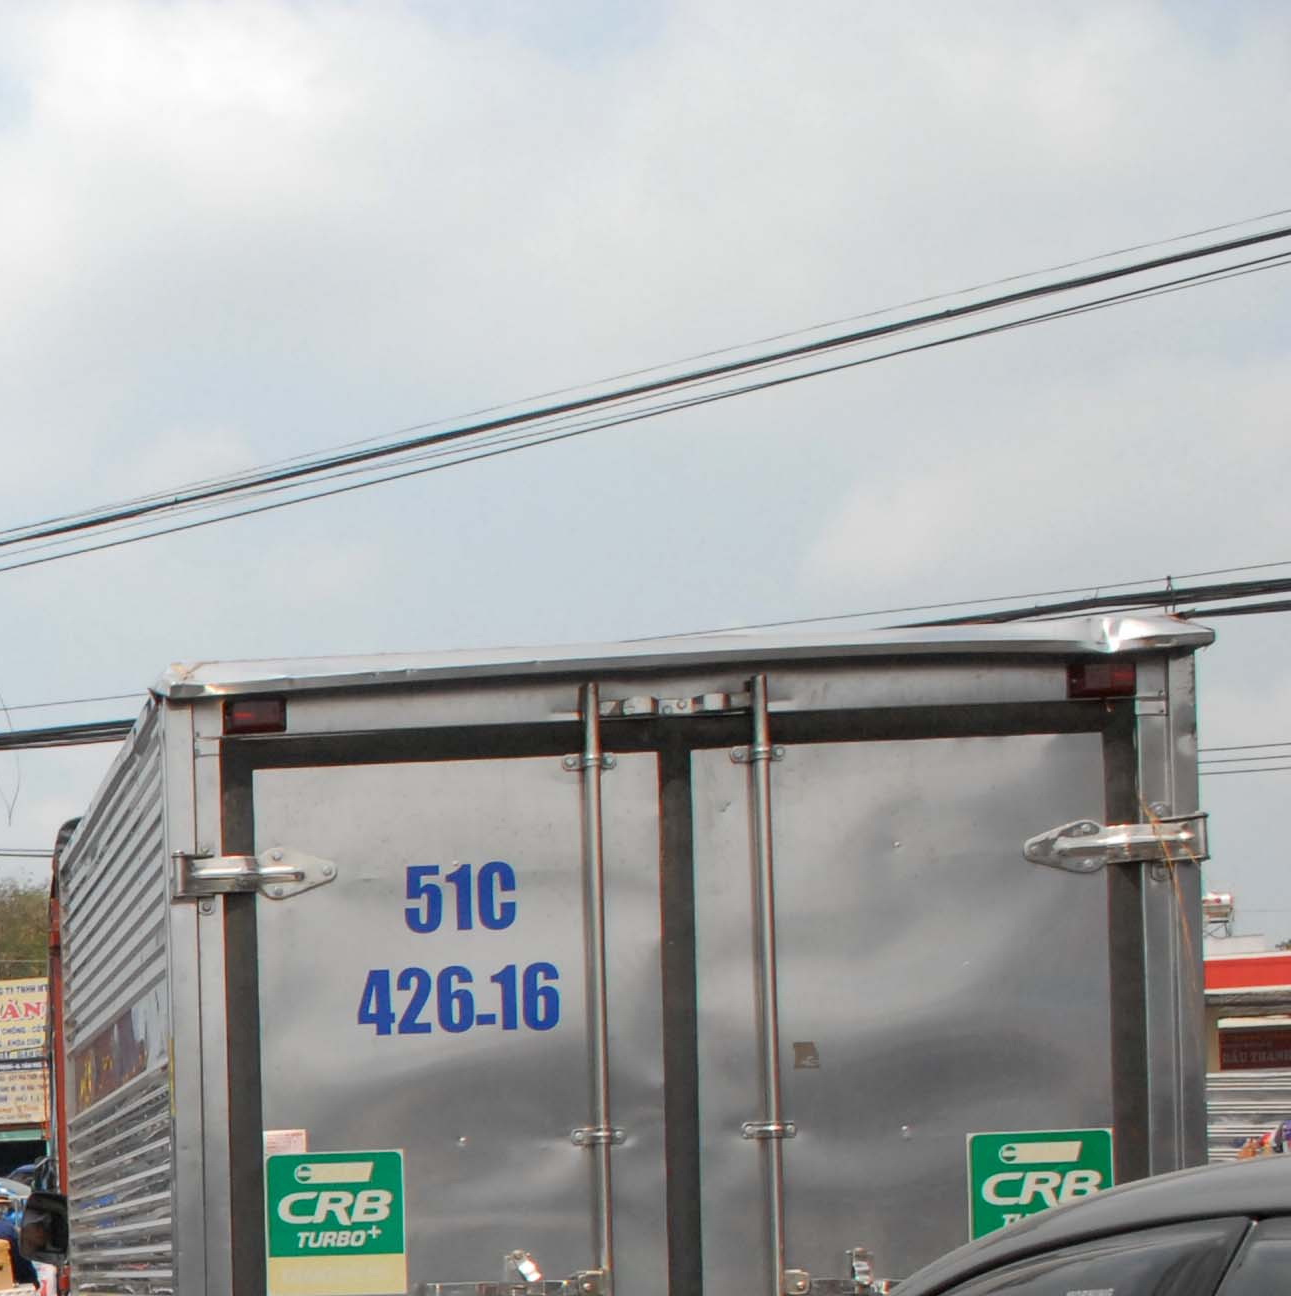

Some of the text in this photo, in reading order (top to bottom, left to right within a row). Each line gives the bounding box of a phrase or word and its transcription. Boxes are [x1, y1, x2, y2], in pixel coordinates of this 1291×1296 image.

[404, 861, 517, 934] 51C
[357, 961, 560, 1036] 426-16
[277, 1188, 393, 1226] CRB
[981, 1169, 1103, 1209] CRB
